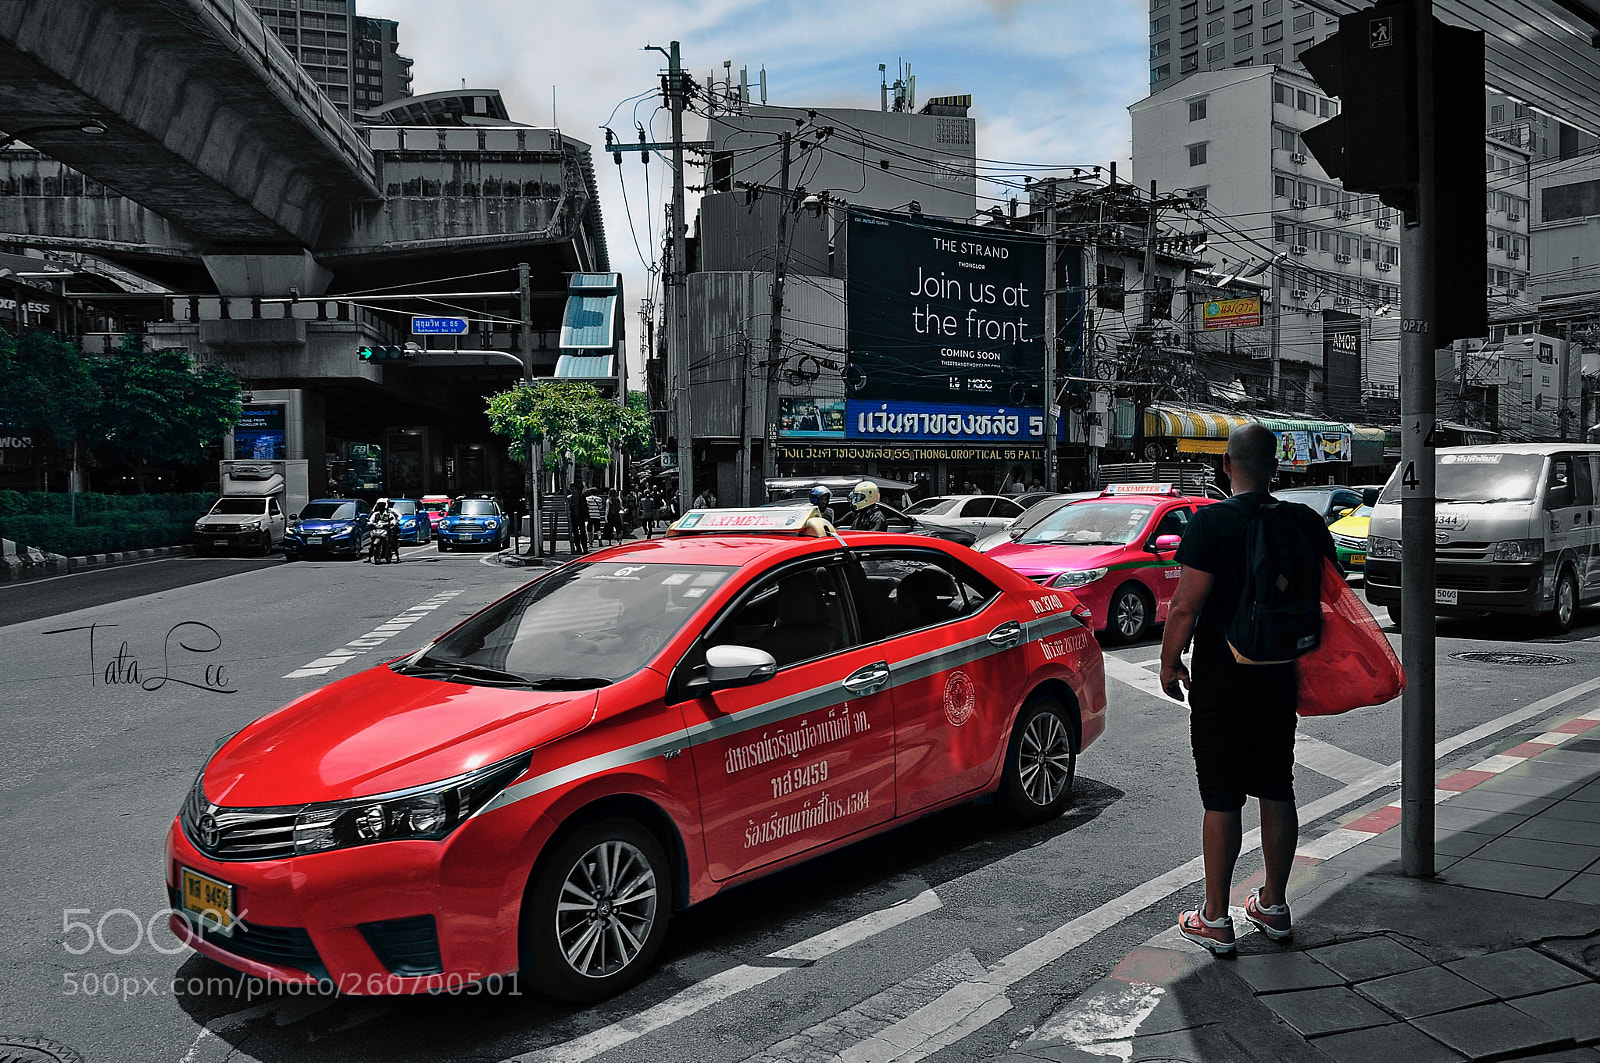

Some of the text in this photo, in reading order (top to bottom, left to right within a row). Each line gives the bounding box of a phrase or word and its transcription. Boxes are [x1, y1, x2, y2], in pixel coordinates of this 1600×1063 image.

[932, 237, 1009, 260] THE STRAND
[958, 261, 986, 271] THONGLOR
[910, 266, 1030, 308] Join us at
[912, 303, 1033, 343] the front.
[940, 347, 1001, 361] COMING SOON
[1332, 332, 1357, 351] AMOR
[857, 402, 1020, 436] แว่นตาทองหล่อ
[894, 449, 911, 460] 55
[914, 449, 1002, 460] THONGLOROPTICAL
[1003, 449, 1017, 460] 55
[1401, 460, 1420, 491] 4
[793, 761, 829, 791] 9459
[205, 883, 229, 911] 9459
